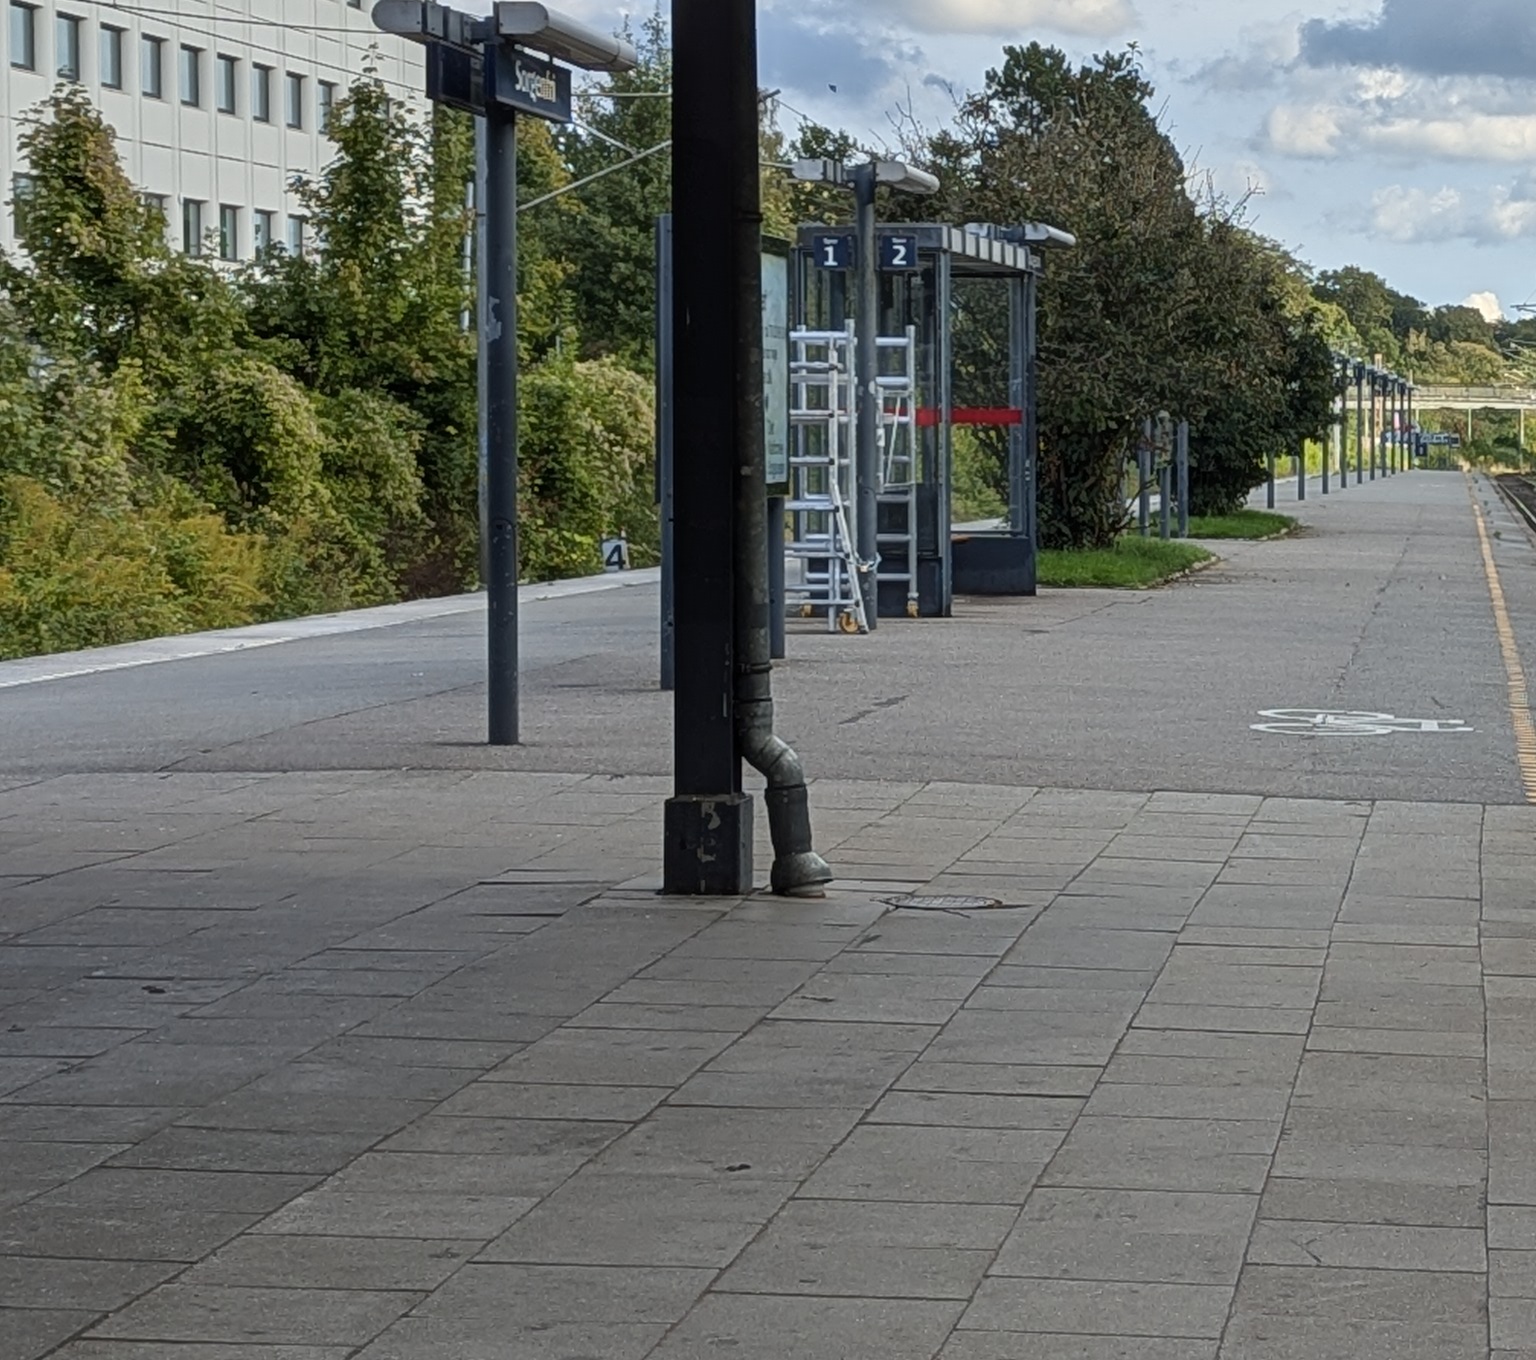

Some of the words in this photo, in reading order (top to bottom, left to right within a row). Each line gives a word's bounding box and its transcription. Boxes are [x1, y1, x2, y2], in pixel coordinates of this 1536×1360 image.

[823, 245, 838, 266] 1
[892, 244, 907, 265] 2
[605, 544, 626, 570] 4
